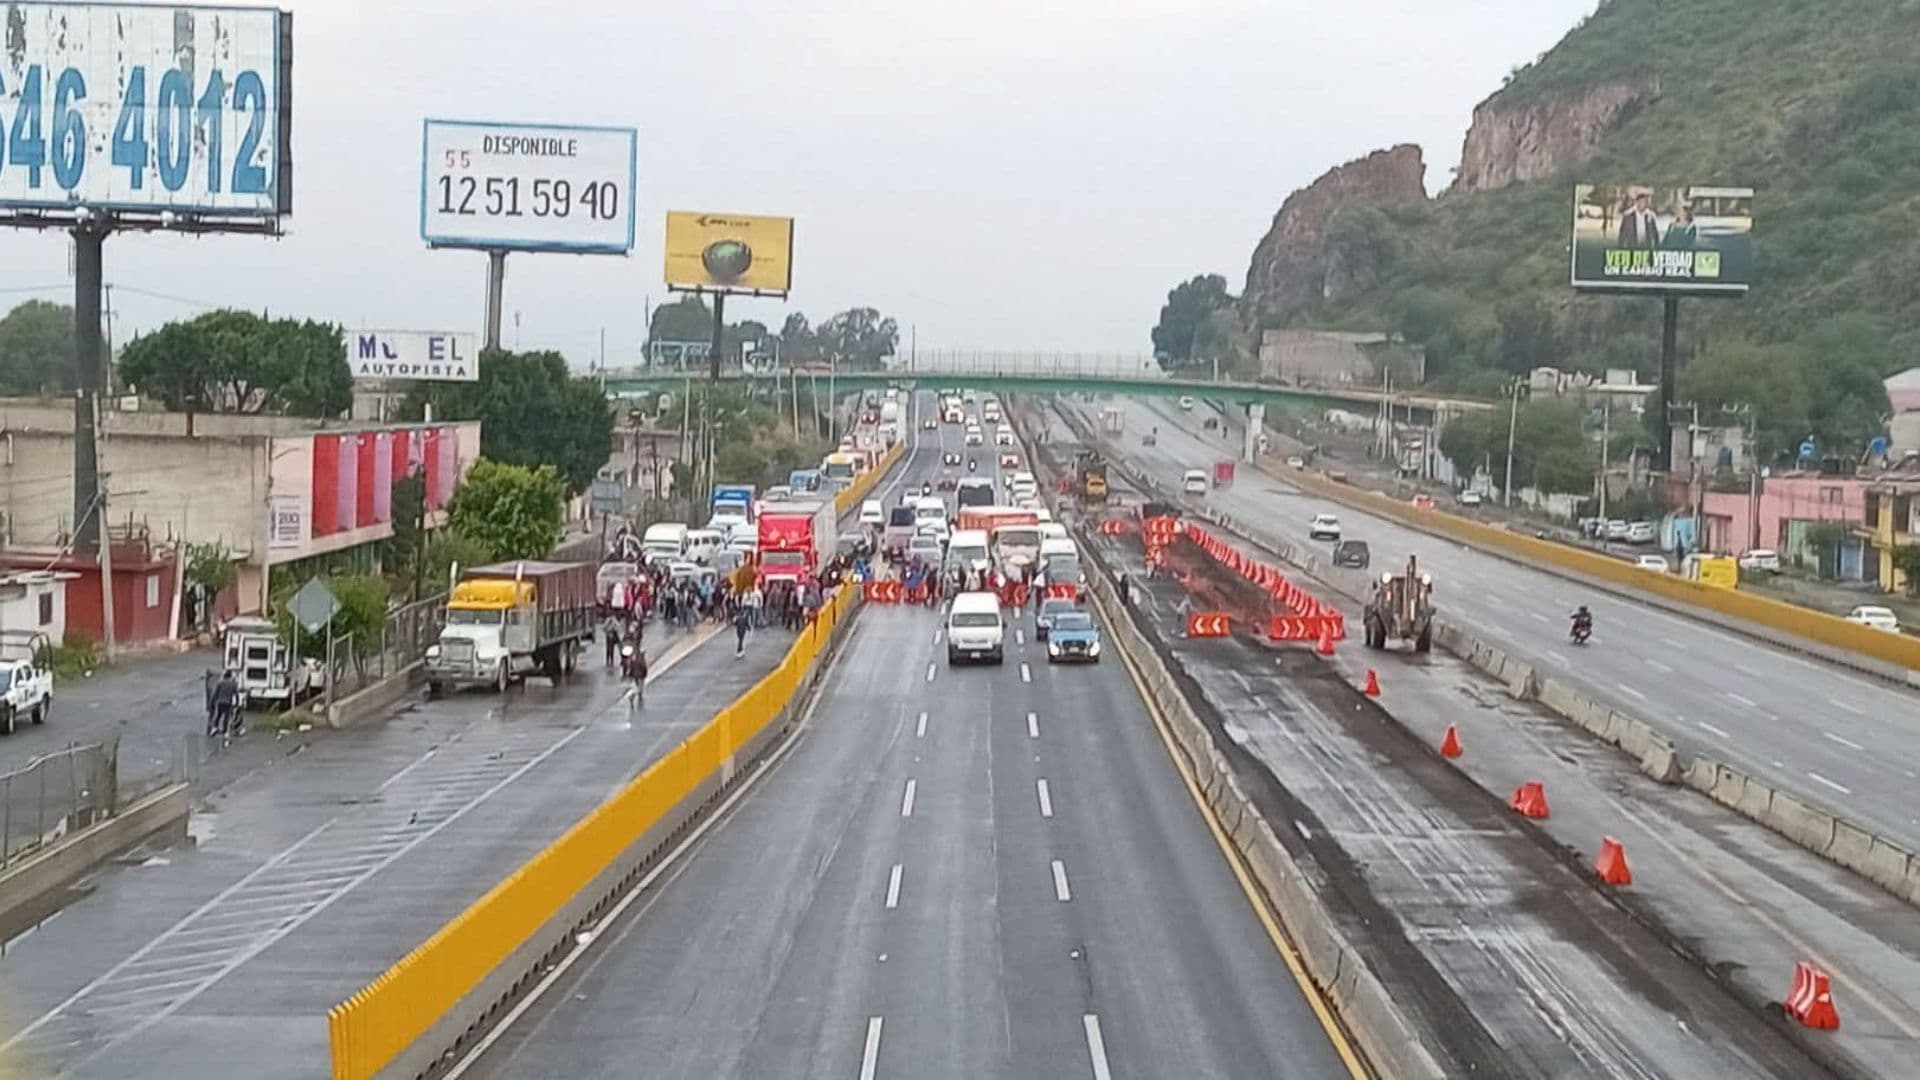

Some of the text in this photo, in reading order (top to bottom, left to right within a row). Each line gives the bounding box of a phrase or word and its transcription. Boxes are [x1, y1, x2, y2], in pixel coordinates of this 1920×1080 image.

[0, 64, 267, 194] 46 4012
[483, 135, 577, 156] DISPONIBLE
[360, 363, 466, 377] AUTOPISTA
